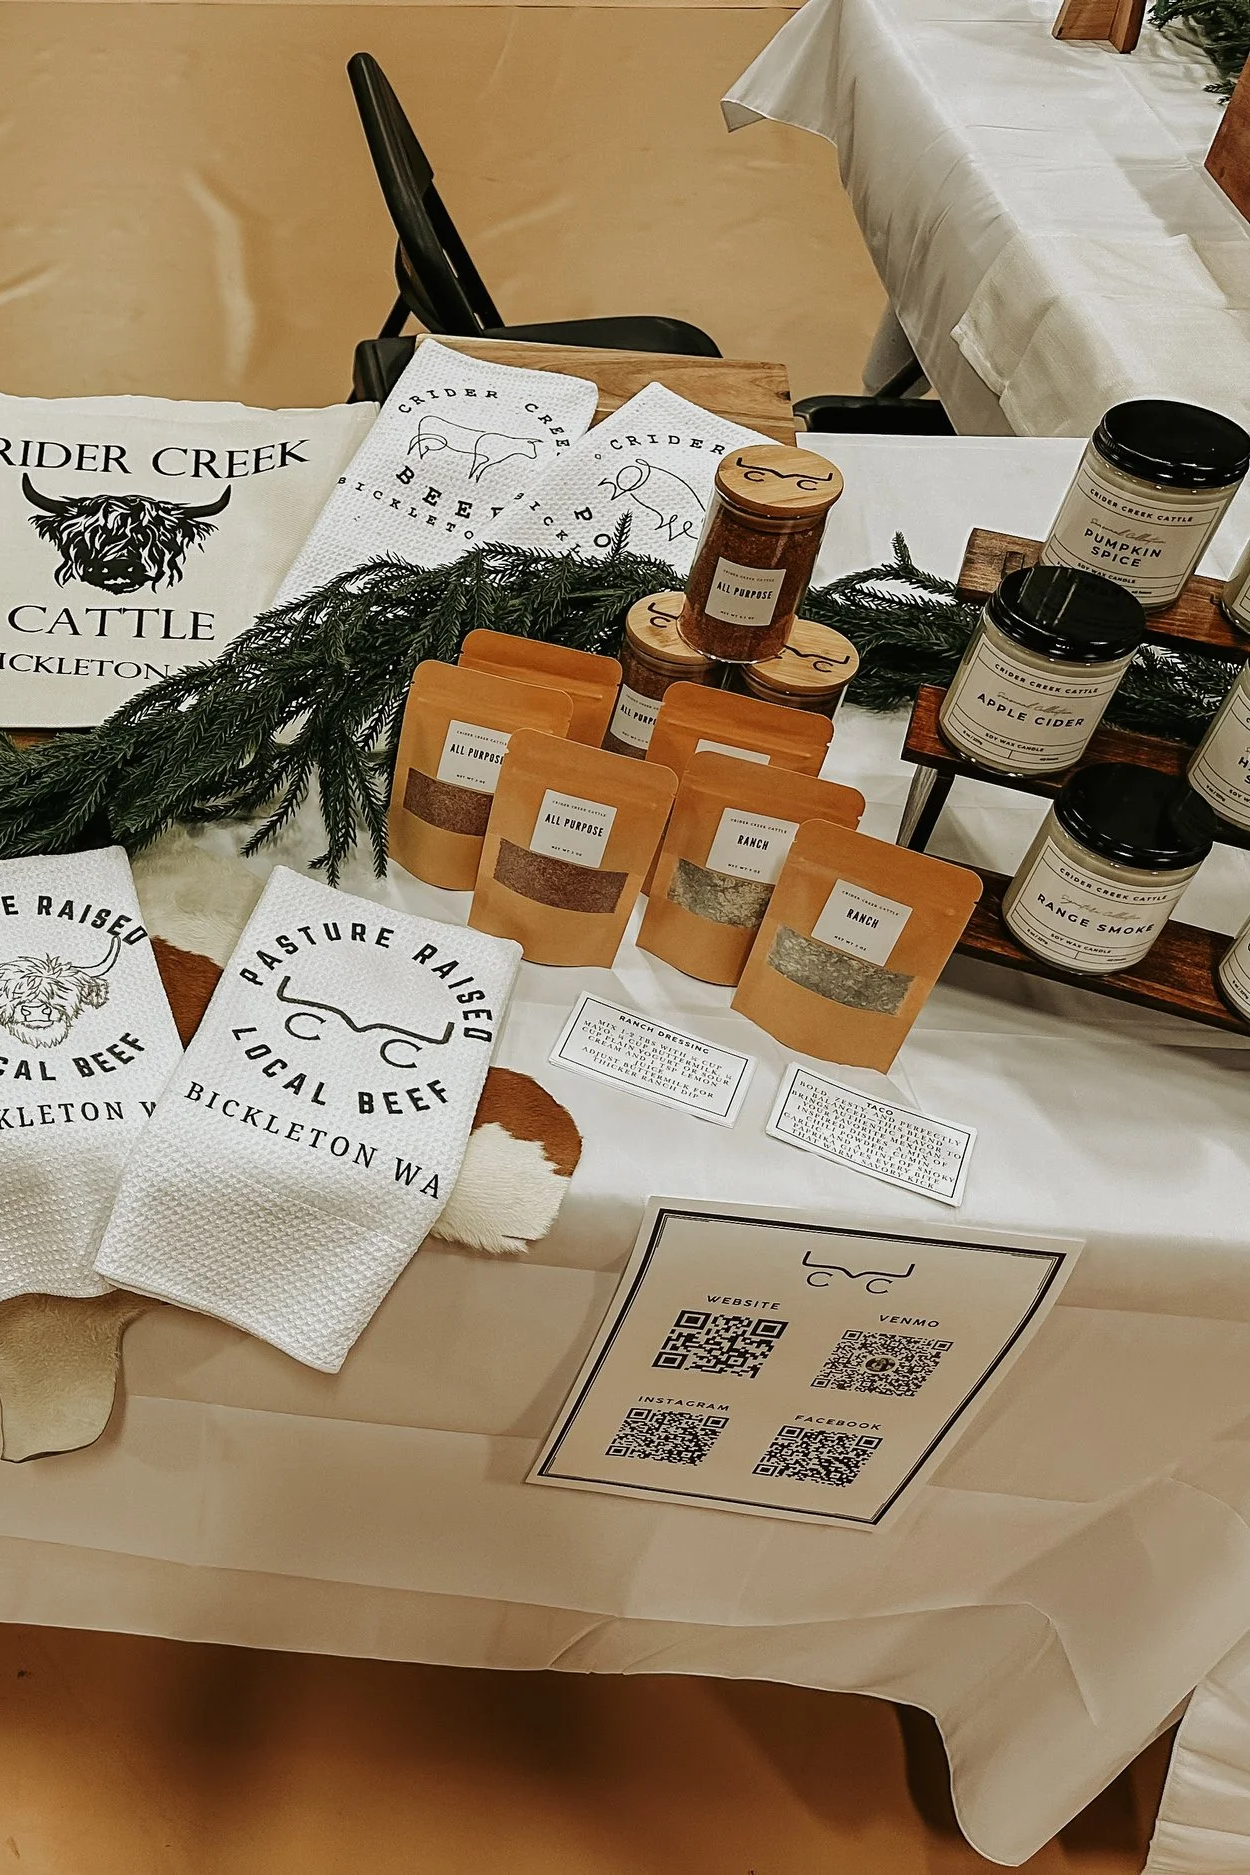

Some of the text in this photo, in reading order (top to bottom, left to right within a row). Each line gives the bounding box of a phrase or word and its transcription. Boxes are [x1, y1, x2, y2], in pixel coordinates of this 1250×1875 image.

[398, 388, 570, 448] CRIDER CREE
[152, 440, 310, 479] CREEK
[610, 435, 725, 455] CRIDER
[337, 477, 474, 540] BICKLETO
[1090, 489, 1117, 508] CRIDER
[1122, 506, 1153, 518] CREEK
[514, 492, 581, 554] BICKL
[574, 507, 611, 547] PO
[1085, 528, 1161, 557] PUMPKIN
[1091, 546, 1141, 567] SPICE
[717, 582, 773, 600] ALL PURPOSE
[1092, 569, 1105, 577] WAX
[1109, 575, 1135, 583] CANDLE
[8, 605, 215, 640] CATTLE
[995, 664, 1026, 683] CRIDER
[1030, 681, 1061, 692] CREEK
[621, 704, 656, 726] ALL PURP
[978, 694, 1027, 721] APPLE
[1035, 717, 1084, 727] CIDER
[450, 744, 464, 755] ALL
[985, 733, 998, 741] SOY
[1000, 739, 1014, 747] WAX
[1017, 744, 1044, 752] CANDLE
[545, 814, 603, 837] ALL PURPOSE
[737, 835, 769, 850] RANCH
[1060, 868, 1091, 888] CRIDER
[1096, 887, 1128, 900] CREEK
[37, 895, 148, 946] RAISED
[847, 909, 879, 929] RANCH
[1037, 894, 1090, 927] RANGE
[1097, 924, 1154, 934] SMOKE
[1084, 945, 1111, 953] CANDLE
[239, 922, 493, 1042] PASTURE RAISED
[619, 1015, 709, 1054] RANCH DRESSING
[72, 1032, 145, 1078] BEEF
[232, 1027, 448, 1114] LOCAL BEEF
[582, 1046, 714, 1098] ADJUST BUTTERMILK FOR
[594, 1057, 699, 1099] THICKER RANCH DIP
[139, 1101, 156, 1118] W
[867, 1102, 893, 1115] TACO
[184, 1081, 440, 1199] BICKLETON WA
[707, 1295, 940, 1328] WEBSITE VENMO
[638, 1396, 882, 1430] INSTAGRAM FACEBOOK
